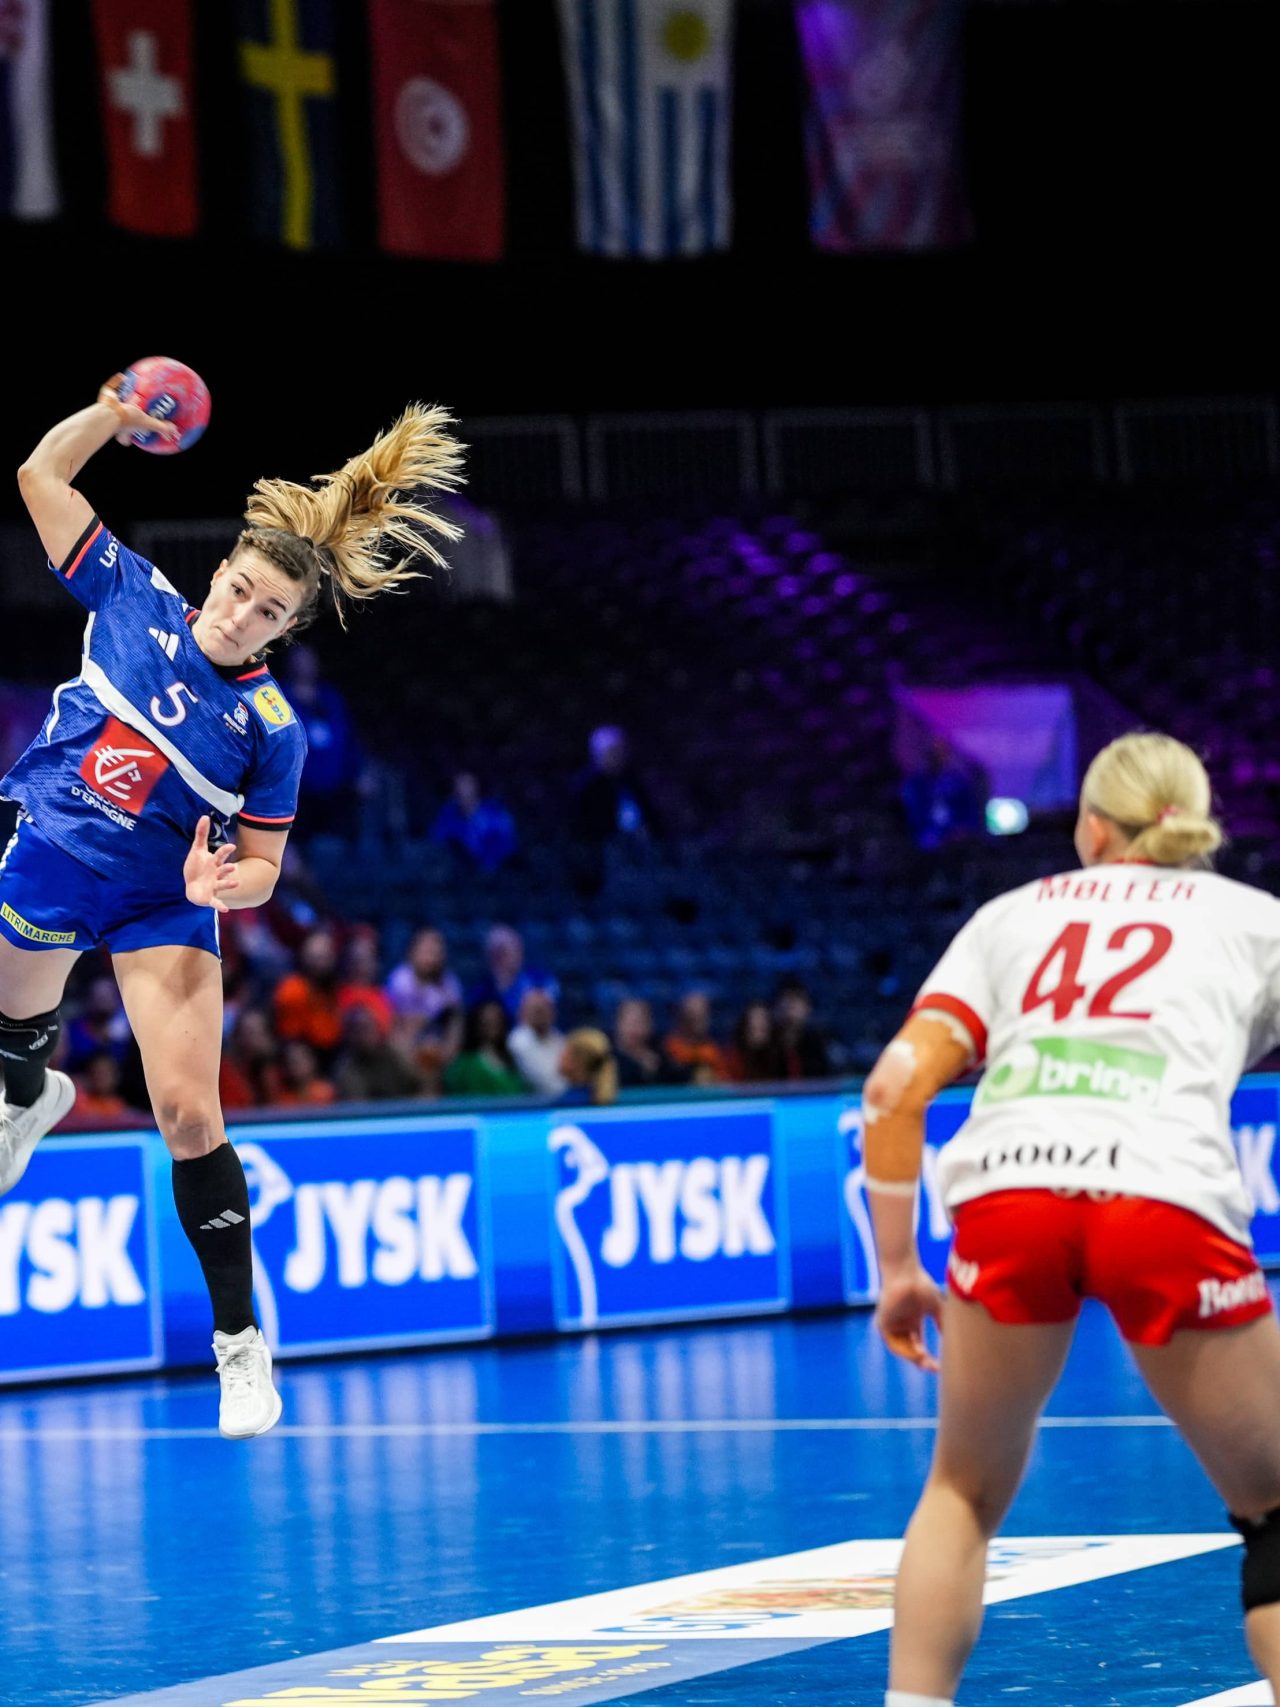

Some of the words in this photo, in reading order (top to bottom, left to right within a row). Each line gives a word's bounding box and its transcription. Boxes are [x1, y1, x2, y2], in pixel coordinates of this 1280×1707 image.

[150, 682, 199, 727] 5
[71, 785, 137, 831] D'EPARGNE
[1021, 920, 1173, 1023] 42
[1040, 1053, 1160, 1106] bring
[284, 1172, 479, 1293] JYSK
[601, 1153, 776, 1268] JYSK
